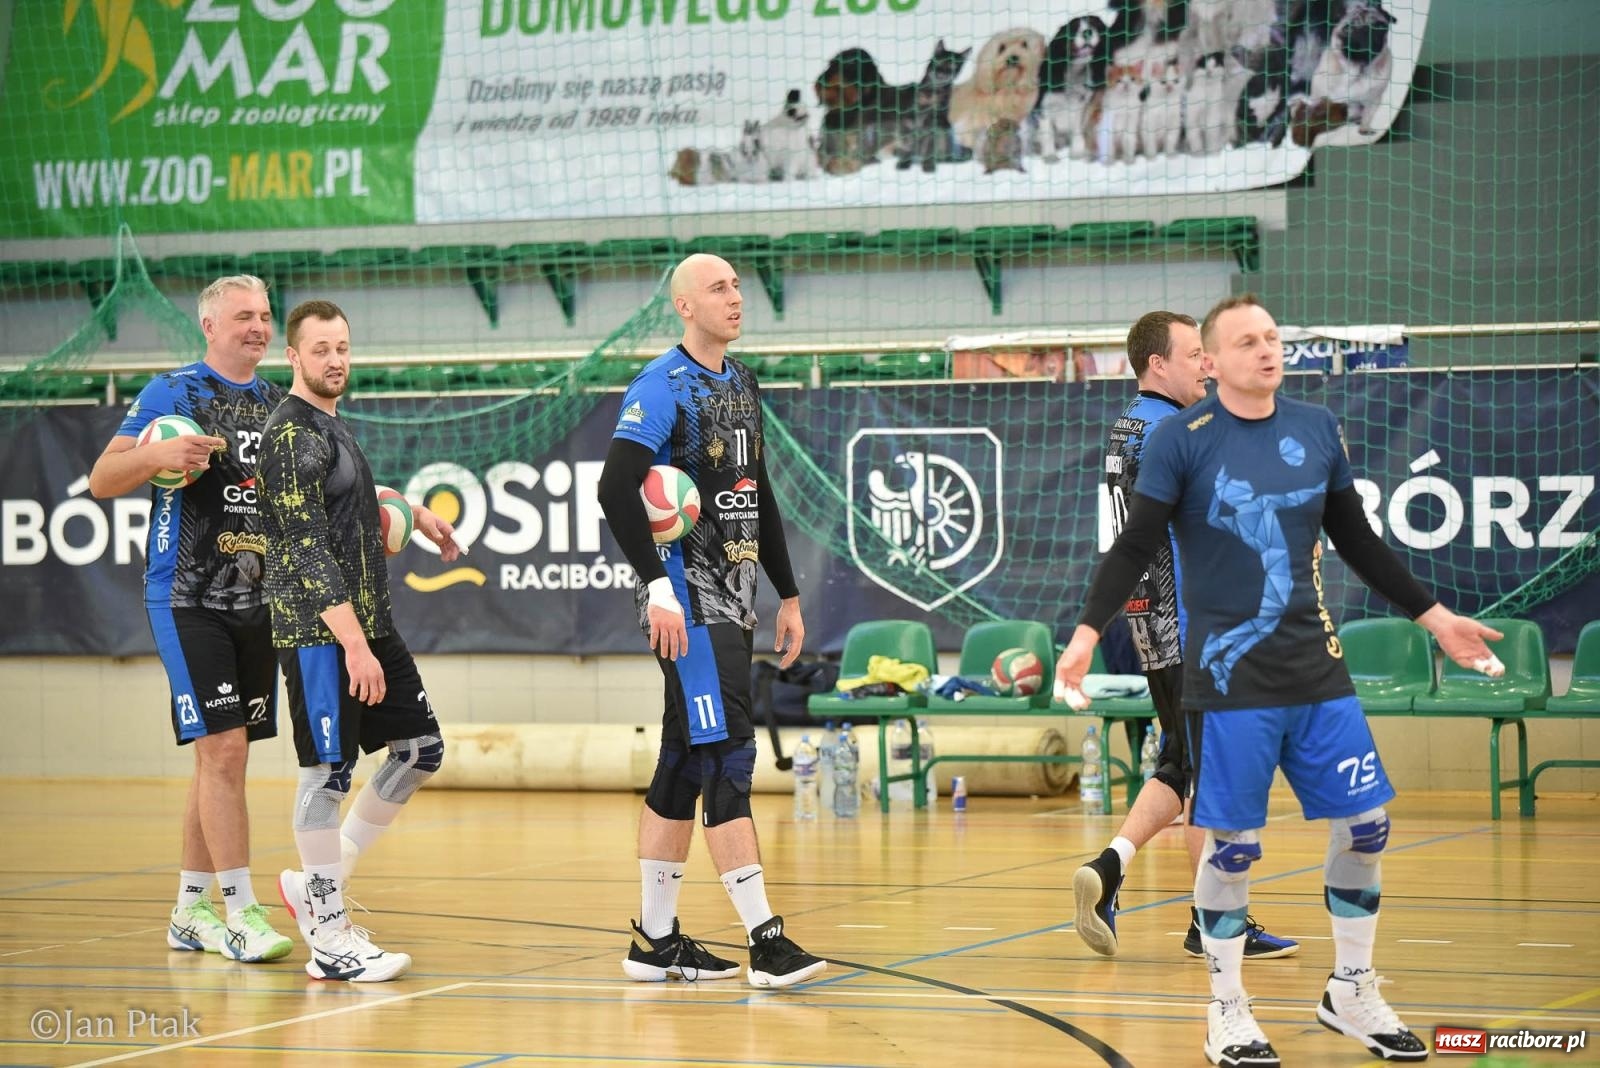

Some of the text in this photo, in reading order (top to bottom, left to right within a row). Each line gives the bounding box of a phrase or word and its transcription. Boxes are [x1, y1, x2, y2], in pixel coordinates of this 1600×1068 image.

[159, 20, 391, 99] MAR
[466, 67, 727, 104] Dzielimy się naszą pasją
[153, 102, 386, 128] sklep zoologiczny
[549, 109, 579, 129] od
[586, 108, 641, 128] 1989
[644, 104, 699, 126] roku
[34, 148, 370, 210] WWW.ZOO-MAR.PL
[734, 429, 748, 466] 11
[2, 473, 152, 566] BÓR
[223, 504, 257, 515] POKRYCIA
[500, 554, 637, 590] RACIBÓR
[177, 693, 199, 725] 23
[693, 693, 717, 730] 11
[320, 716, 331, 749] 9
